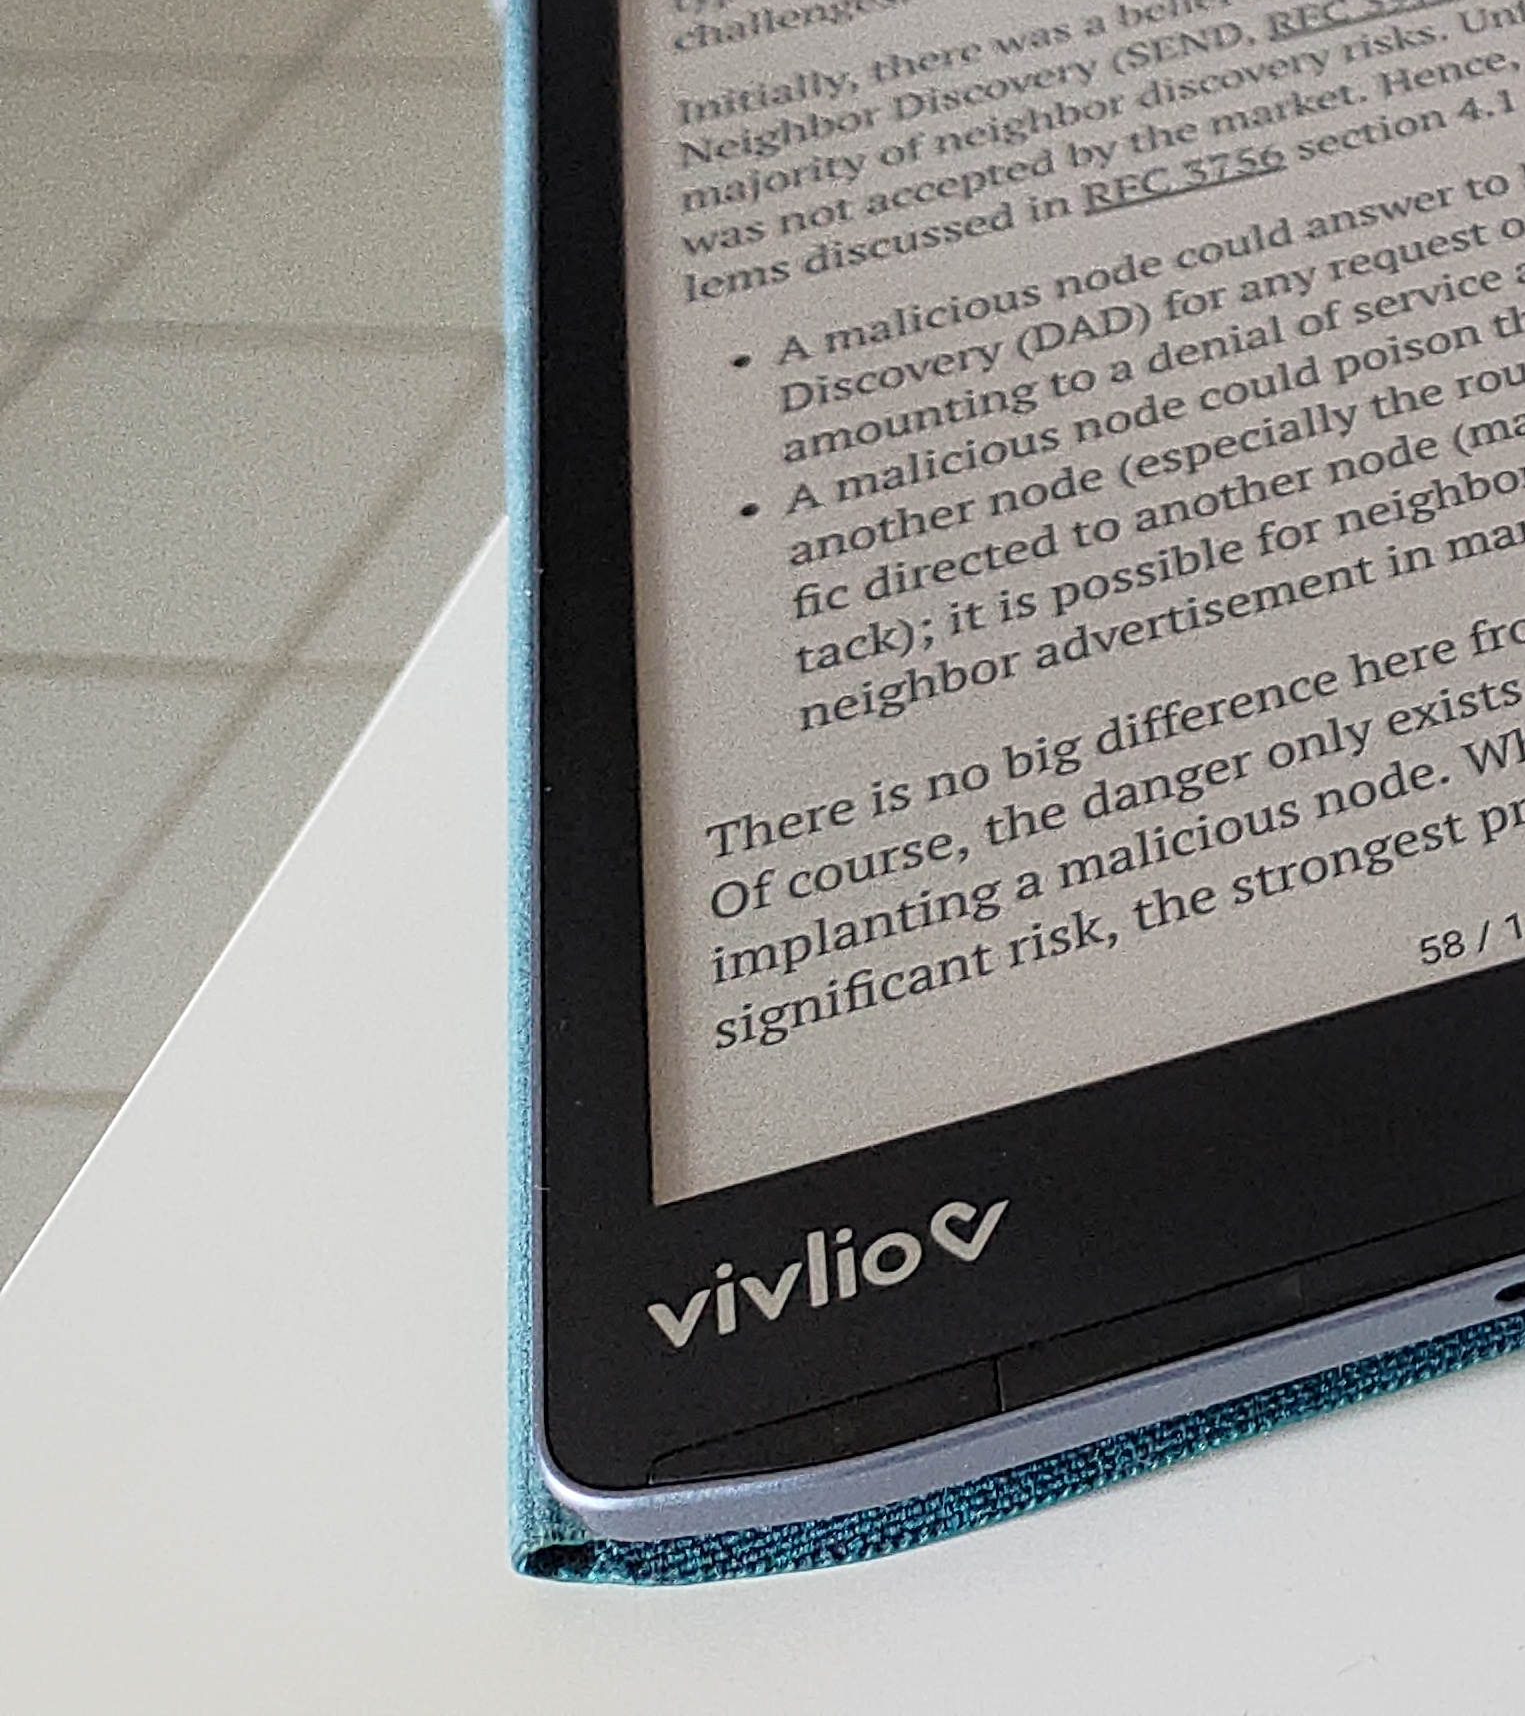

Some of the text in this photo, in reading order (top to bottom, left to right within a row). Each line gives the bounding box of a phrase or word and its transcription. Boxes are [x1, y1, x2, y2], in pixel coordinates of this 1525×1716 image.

[681, 153, 867, 215] majority
[877, 132, 925, 167] of
[934, 94, 1125, 156] neighbor
[1134, 49, 1330, 110] discovery
[1341, 25, 1449, 64] risks.
[685, 260, 791, 304] lems
[801, 201, 1015, 276] discussed
[1027, 195, 1071, 225] in
[1081, 166, 1173, 218] RFC
[1294, 109, 1448, 162] section
[1455, 88, 1516, 123] 4.1
[775, 334, 813, 367] A
[823, 284, 1042, 355] malicious
[1053, 253, 1163, 301] node
[1171, 217, 1295, 272] could
[1302, 186, 1454, 241] answer
[1462, 174, 1510, 202] to
[779, 341, 1004, 416] Discovery
[1013, 302, 1152, 363] (DAD)
[1162, 287, 1227, 322] for
[1237, 266, 1317, 304] any
[1326, 223, 1490, 283] request
[781, 381, 1039, 466] amounting
[1046, 369, 1097, 399] to
[1108, 360, 1135, 385] a
[1145, 314, 1286, 375] denial
[1294, 299, 1342, 338] of
[1351, 270, 1503, 326] service
[784, 482, 825, 517] A
[833, 427, 1061, 504] malicious
[1072, 394, 1187, 445] node
[1195, 354, 1321, 412] could
[1331, 325, 1483, 387] poison
[787, 498, 976, 568] another
[987, 465, 1104, 518] node
[1116, 402, 1359, 490] (especially
[1368, 384, 1444, 421] the
[790, 582, 850, 622] fic
[862, 522, 1060, 602] directed
[1069, 517, 1121, 550] to
[1134, 467, 1314, 534] another
[1324, 434, 1439, 486] node
[794, 618, 935, 677] tack);
[947, 601, 987, 638] it
[998, 588, 1038, 625] is
[1049, 536, 1244, 619] possible
[1255, 518, 1323, 558] for
[798, 651, 1022, 733] neighbor
[1033, 557, 1377, 671] advertisement
[1386, 544, 1436, 580] in
[704, 799, 856, 859] There
[871, 779, 912, 819] is
[925, 763, 991, 804] no
[1001, 735, 1083, 781] big
[1094, 670, 1339, 756] difference
[1347, 639, 1458, 690] here
[709, 868, 776, 920] Of
[786, 833, 970, 900] course,
[983, 802, 1067, 848] the
[1081, 750, 1253, 821] danger
[1265, 717, 1373, 771] only
[1385, 679, 1523, 738] exists
[711, 879, 1003, 986] implanting
[1014, 870, 1044, 903] a
[1057, 799, 1301, 892] malicious
[1313, 760, 1451, 821] node.
[714, 943, 995, 1051] significant
[1006, 909, 1119, 969] risk,
[1131, 886, 1217, 933] the
[1230, 812, 1468, 908] strongest
[1418, 929, 1466, 967] 58
[1475, 919, 1491, 955] /
[647, 1227, 923, 1349] vivlio
